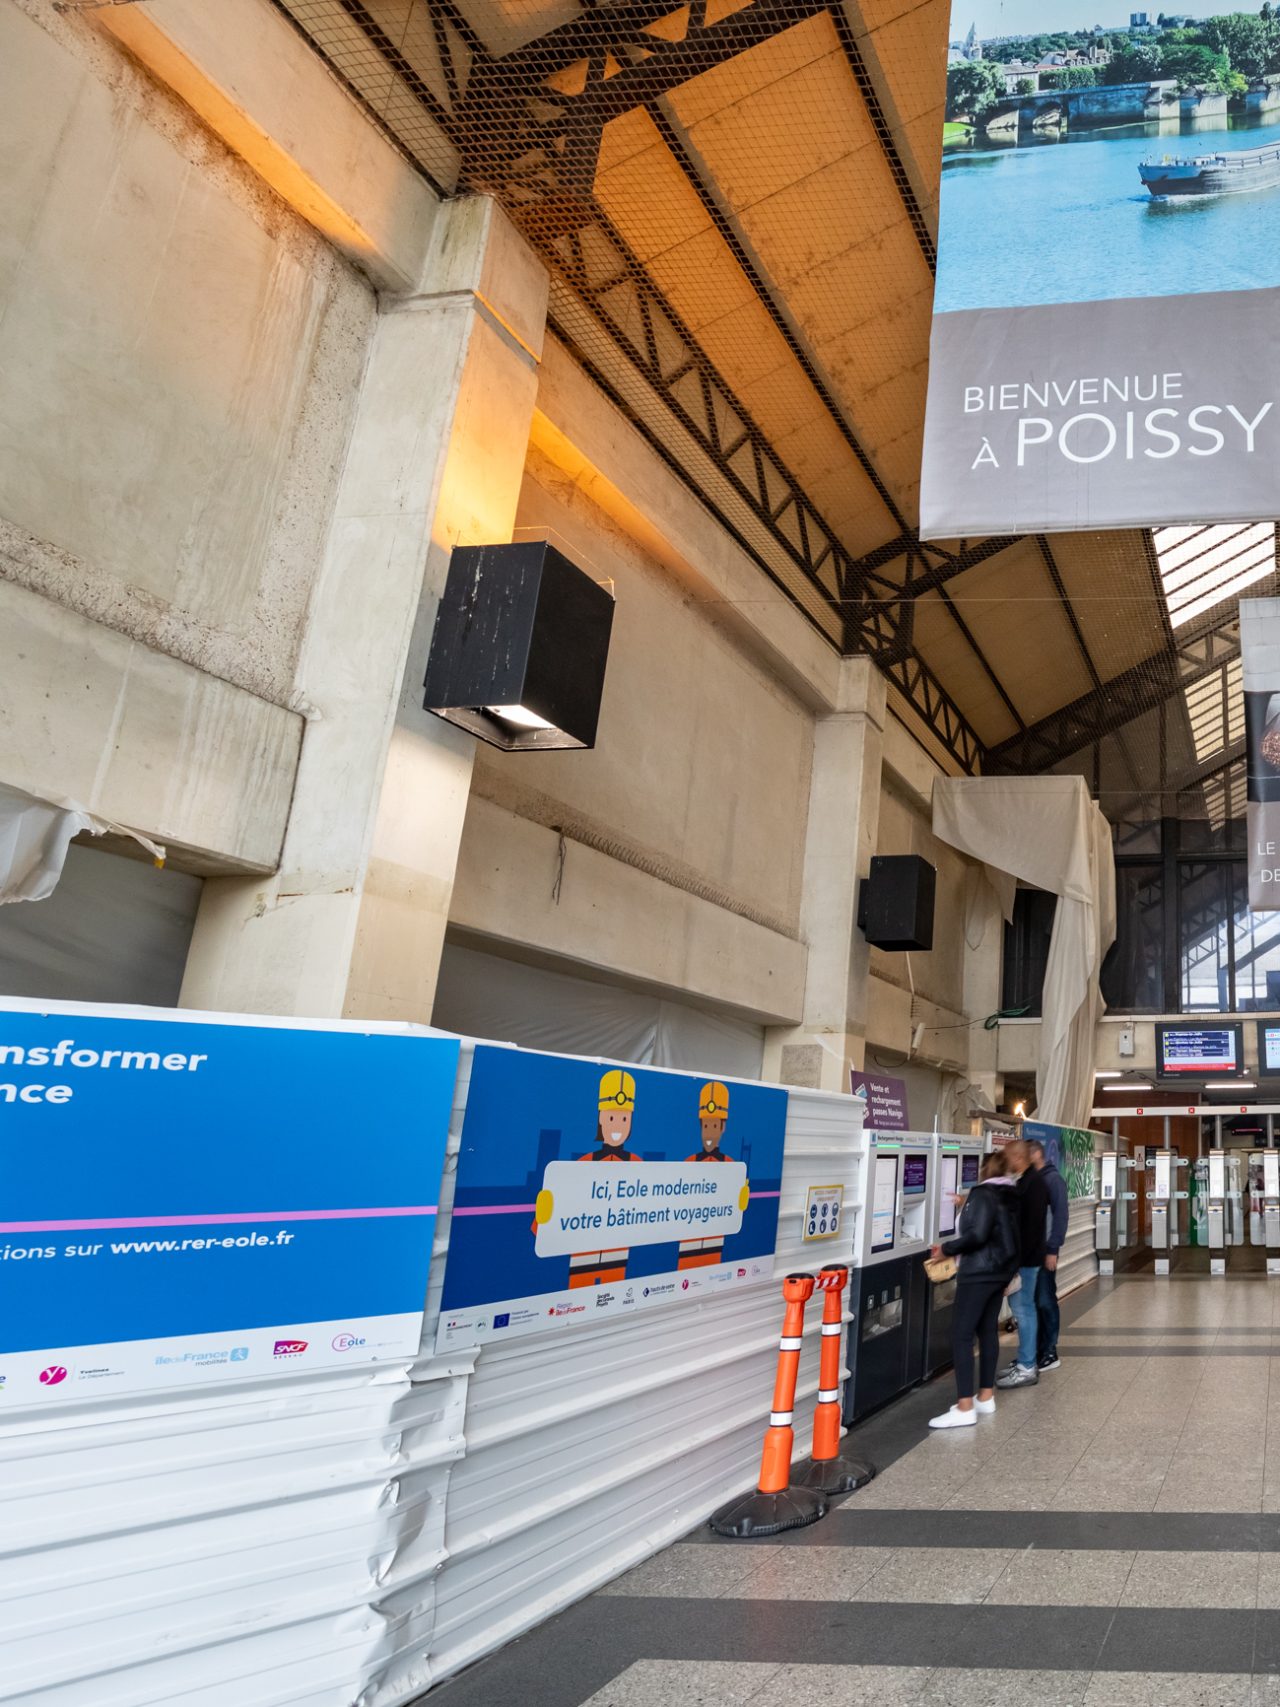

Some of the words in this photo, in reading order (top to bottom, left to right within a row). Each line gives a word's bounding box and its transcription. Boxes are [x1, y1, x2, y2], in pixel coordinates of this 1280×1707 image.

[964, 372, 1183, 413] BIENVENUE
[971, 436, 1000, 470] À
[1017, 402, 1274, 466] POISSY
[1257, 842, 1276, 855] LE
[870, 1082, 884, 1092] Vente
[884, 1085, 890, 1093] et
[871, 1095, 902, 1107] rechargement
[873, 1107, 888, 1118] passes
[888, 1108, 904, 1119] Navigo
[591, 1181, 612, 1201] Ici,
[617, 1179, 648, 1198] Eole
[652, 1178, 717, 1196] modernise
[560, 1213, 602, 1231] votre
[606, 1207, 670, 1227] bâtiment
[673, 1204, 733, 1224] voyageurs
[64, 1243, 103, 1258] sur
[110, 1230, 295, 1255] www.rer-eole.fr
[274, 1342, 307, 1355] SNCF
[340, 1336, 366, 1348] Eole
